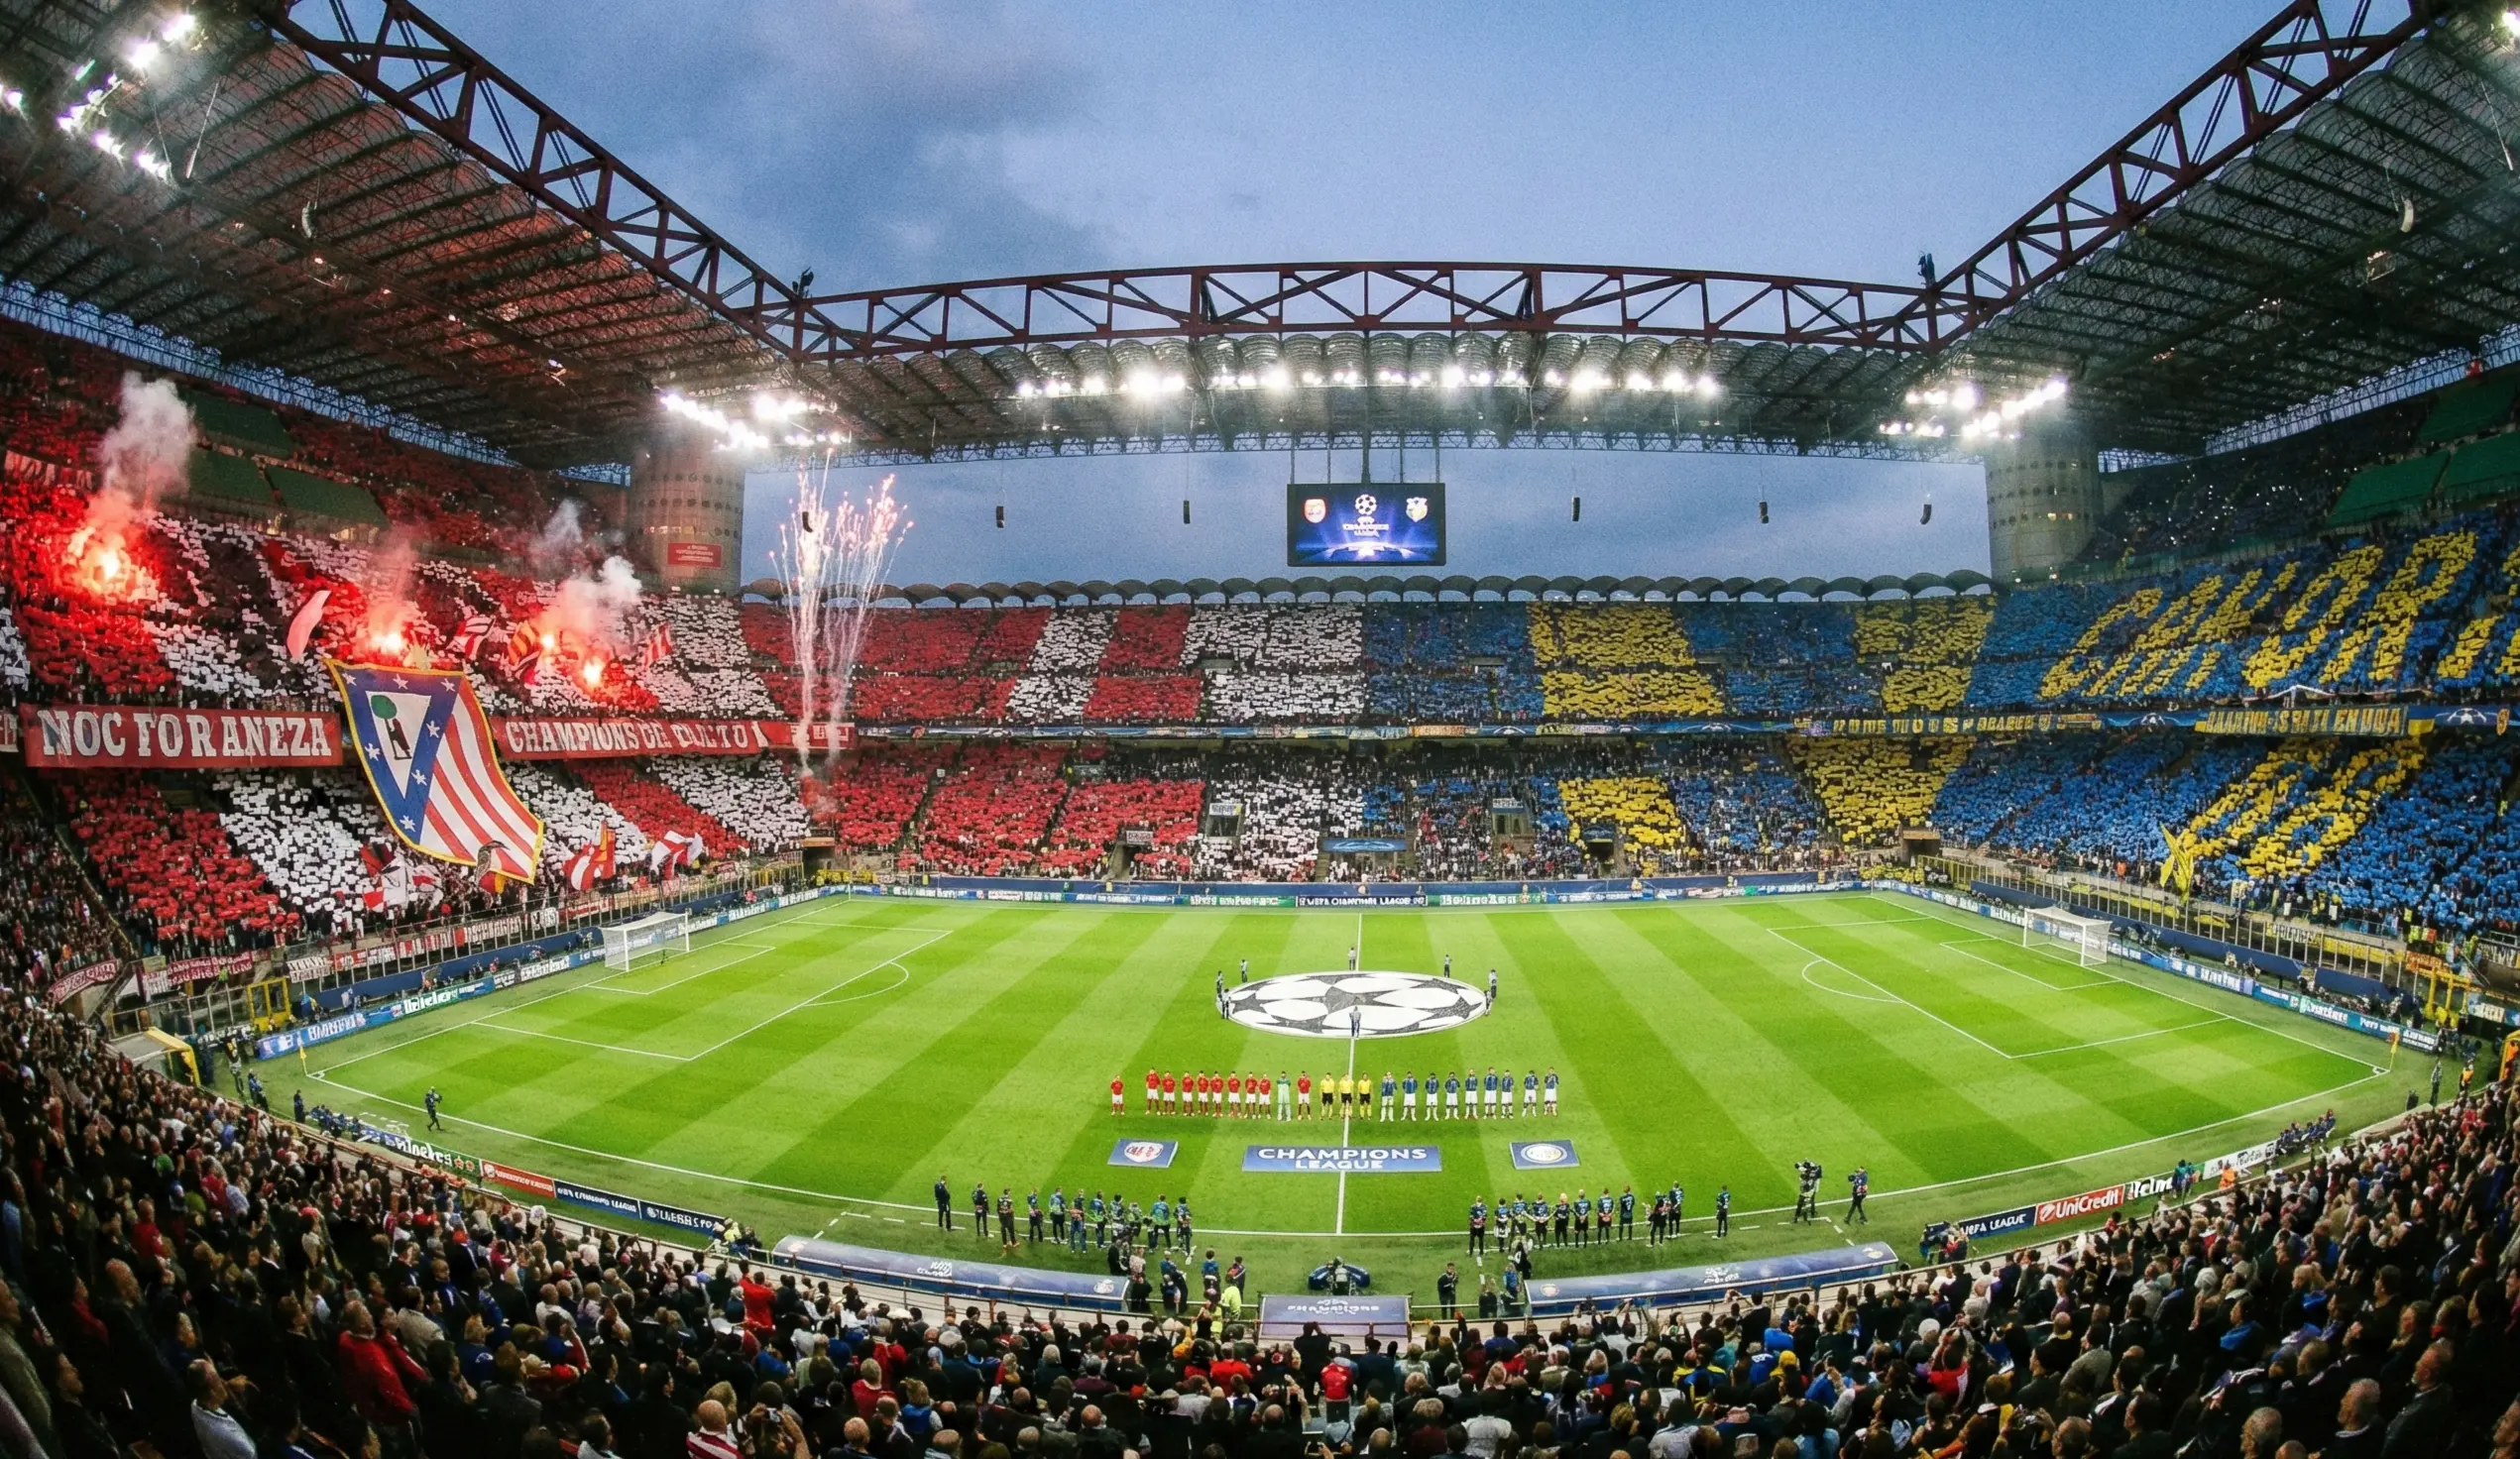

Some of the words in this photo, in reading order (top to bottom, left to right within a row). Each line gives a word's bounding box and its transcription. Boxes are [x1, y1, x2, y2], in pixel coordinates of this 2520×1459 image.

[506, 721, 639, 753] CHAMPIONS
[1258, 1148, 1428, 1160] CHAMPIONS
[1295, 1160, 1384, 1170] LEAGUE
[2054, 1189, 2119, 1219] UniCredit
